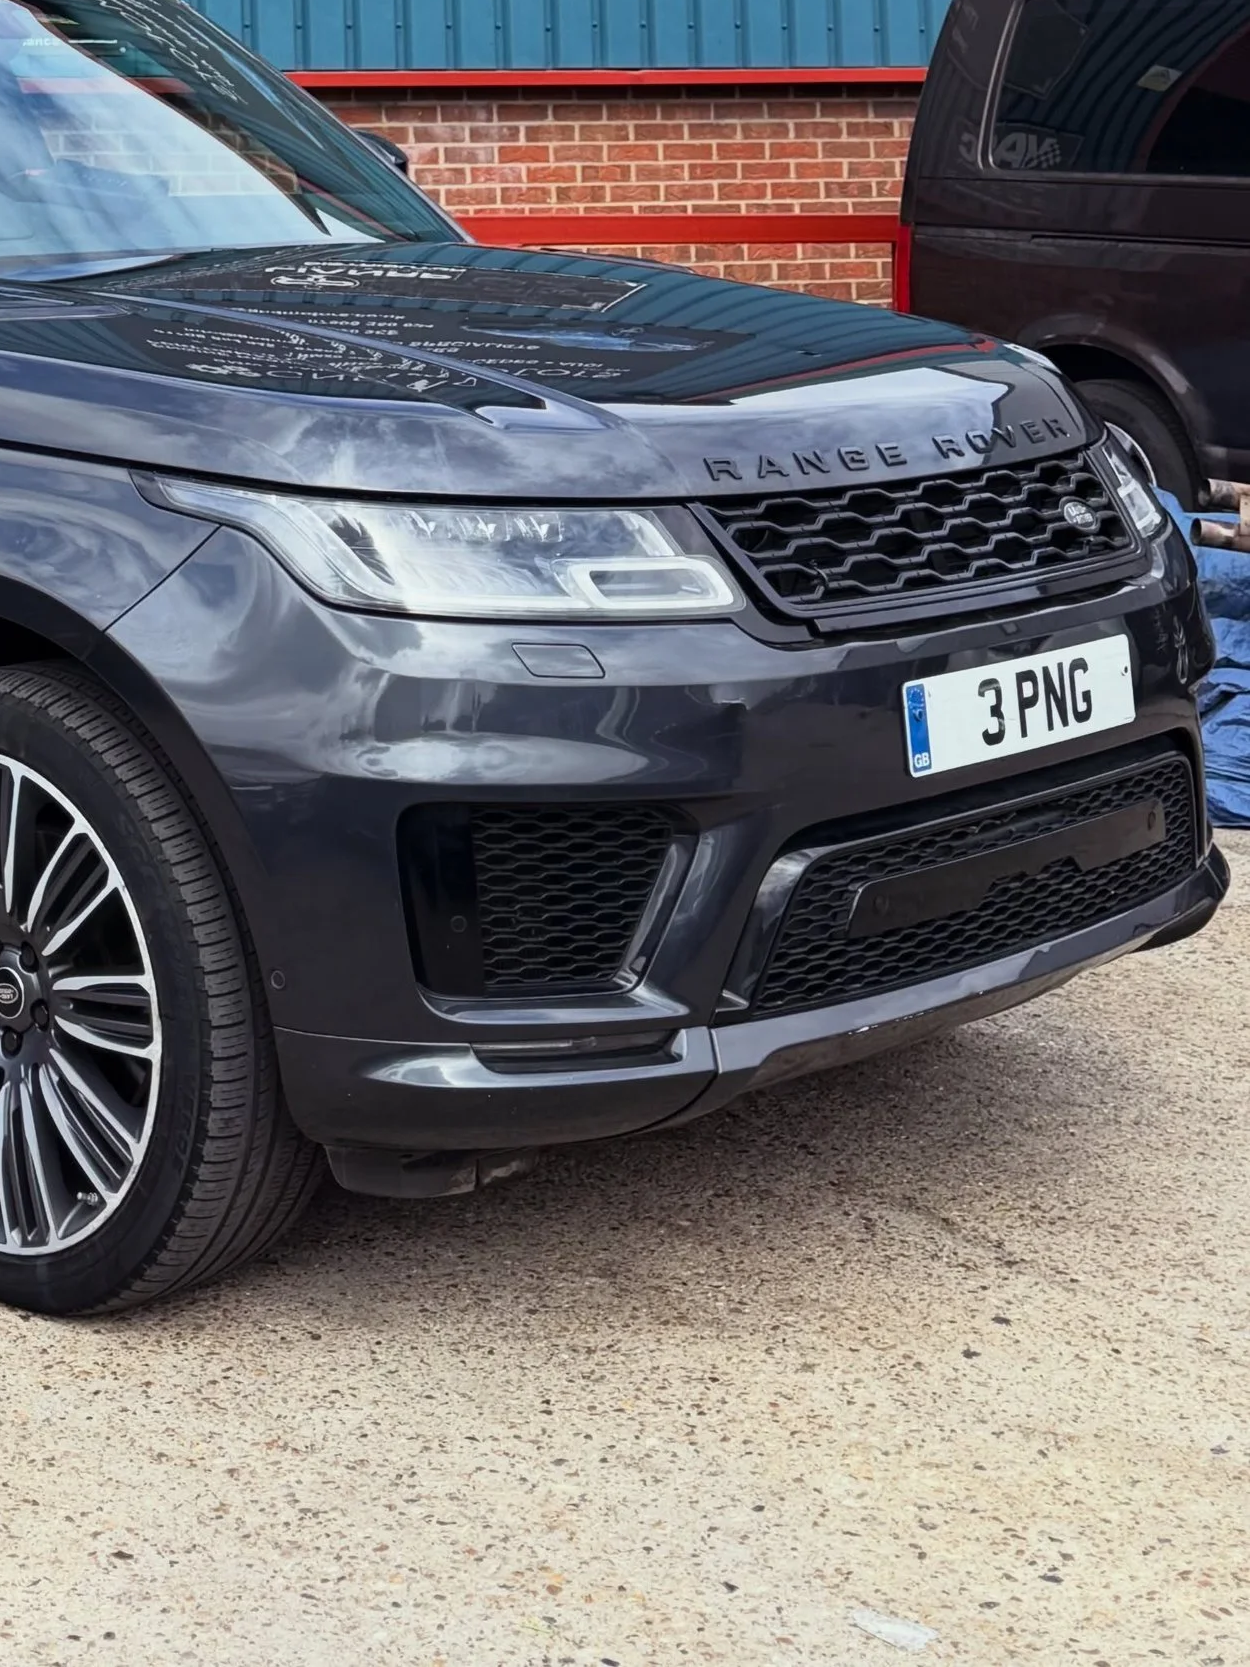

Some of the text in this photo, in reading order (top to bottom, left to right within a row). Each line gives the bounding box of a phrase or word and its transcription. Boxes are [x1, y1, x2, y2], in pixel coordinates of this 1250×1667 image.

[704, 417, 1072, 482] RANGE ROVER
[977, 656, 1093, 747] 3 PNG
[913, 751, 930, 769] GB
